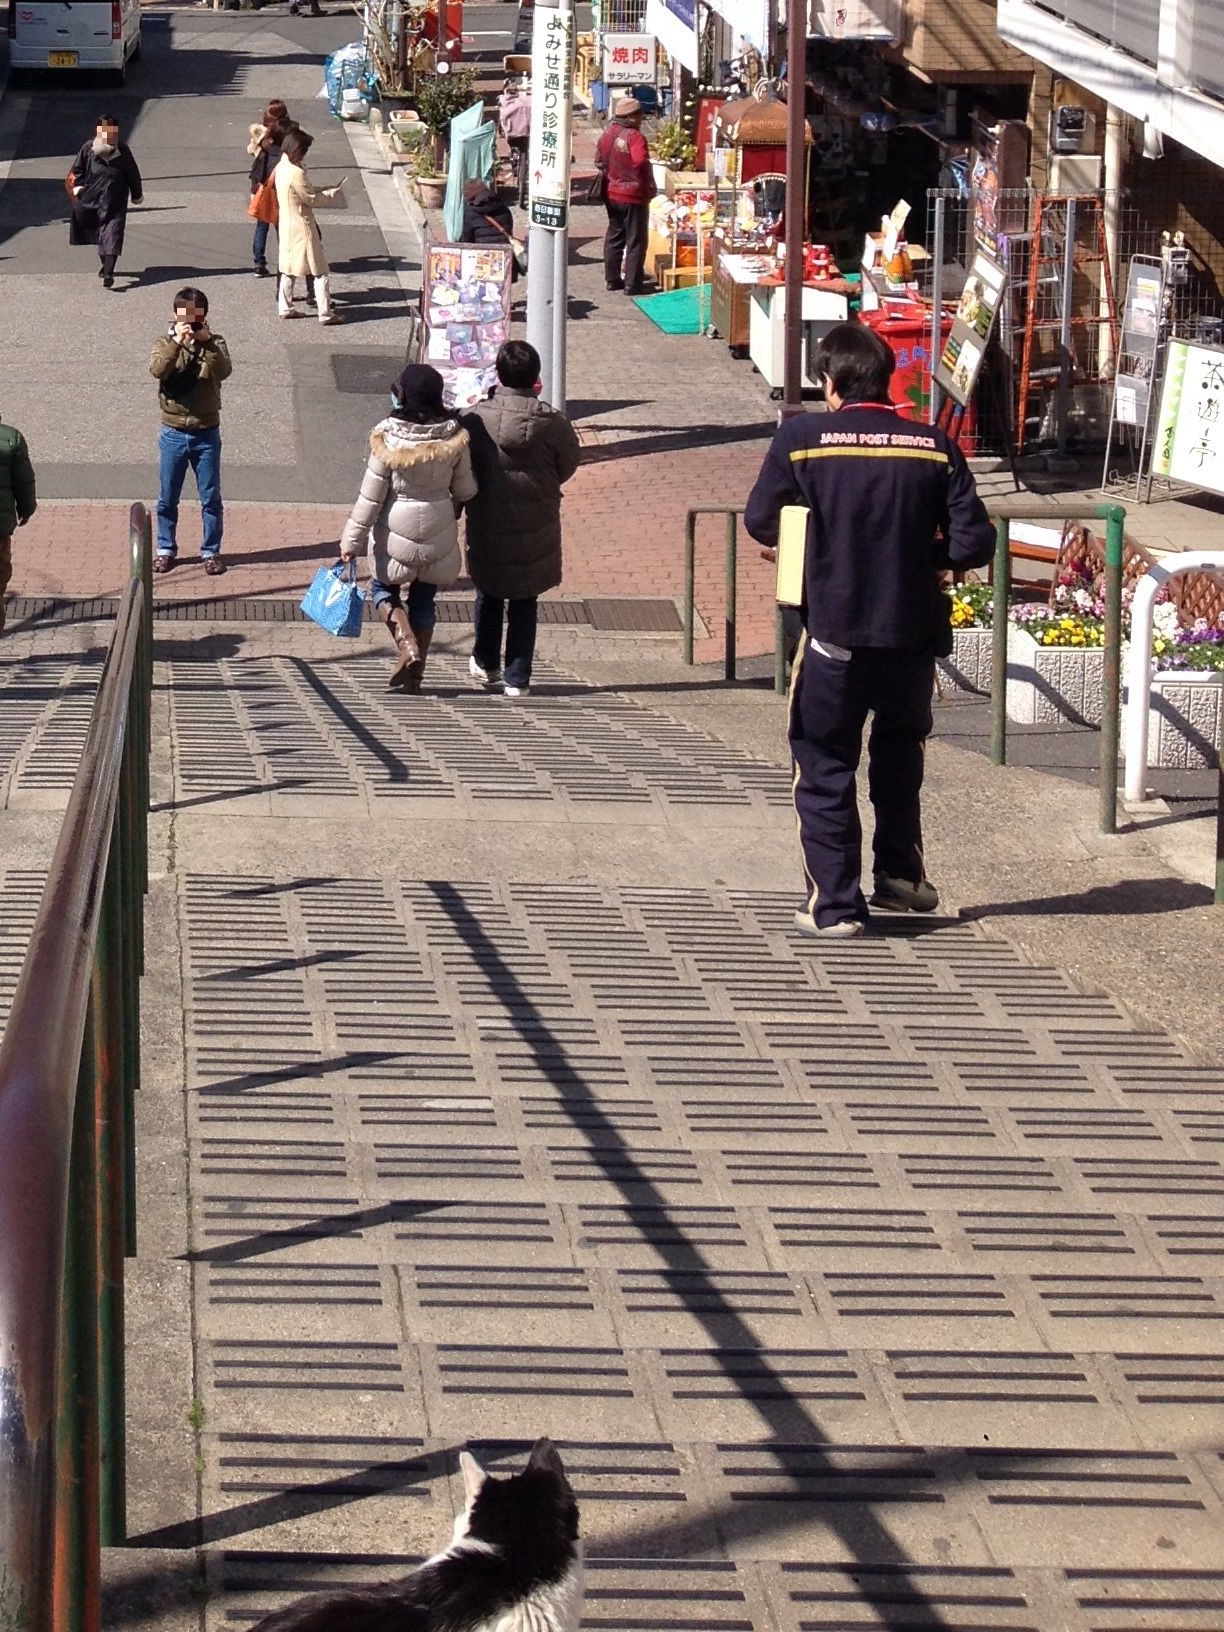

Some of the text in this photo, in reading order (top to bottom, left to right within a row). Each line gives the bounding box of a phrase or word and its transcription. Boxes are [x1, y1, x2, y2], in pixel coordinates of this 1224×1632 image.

[612, 47, 649, 64] 焼肉
[608, 72, 652, 81] サラリーマン
[541, 14, 561, 168] よみせ通り診療所
[820, 432, 935, 448] JAPAN POST SERVICE
